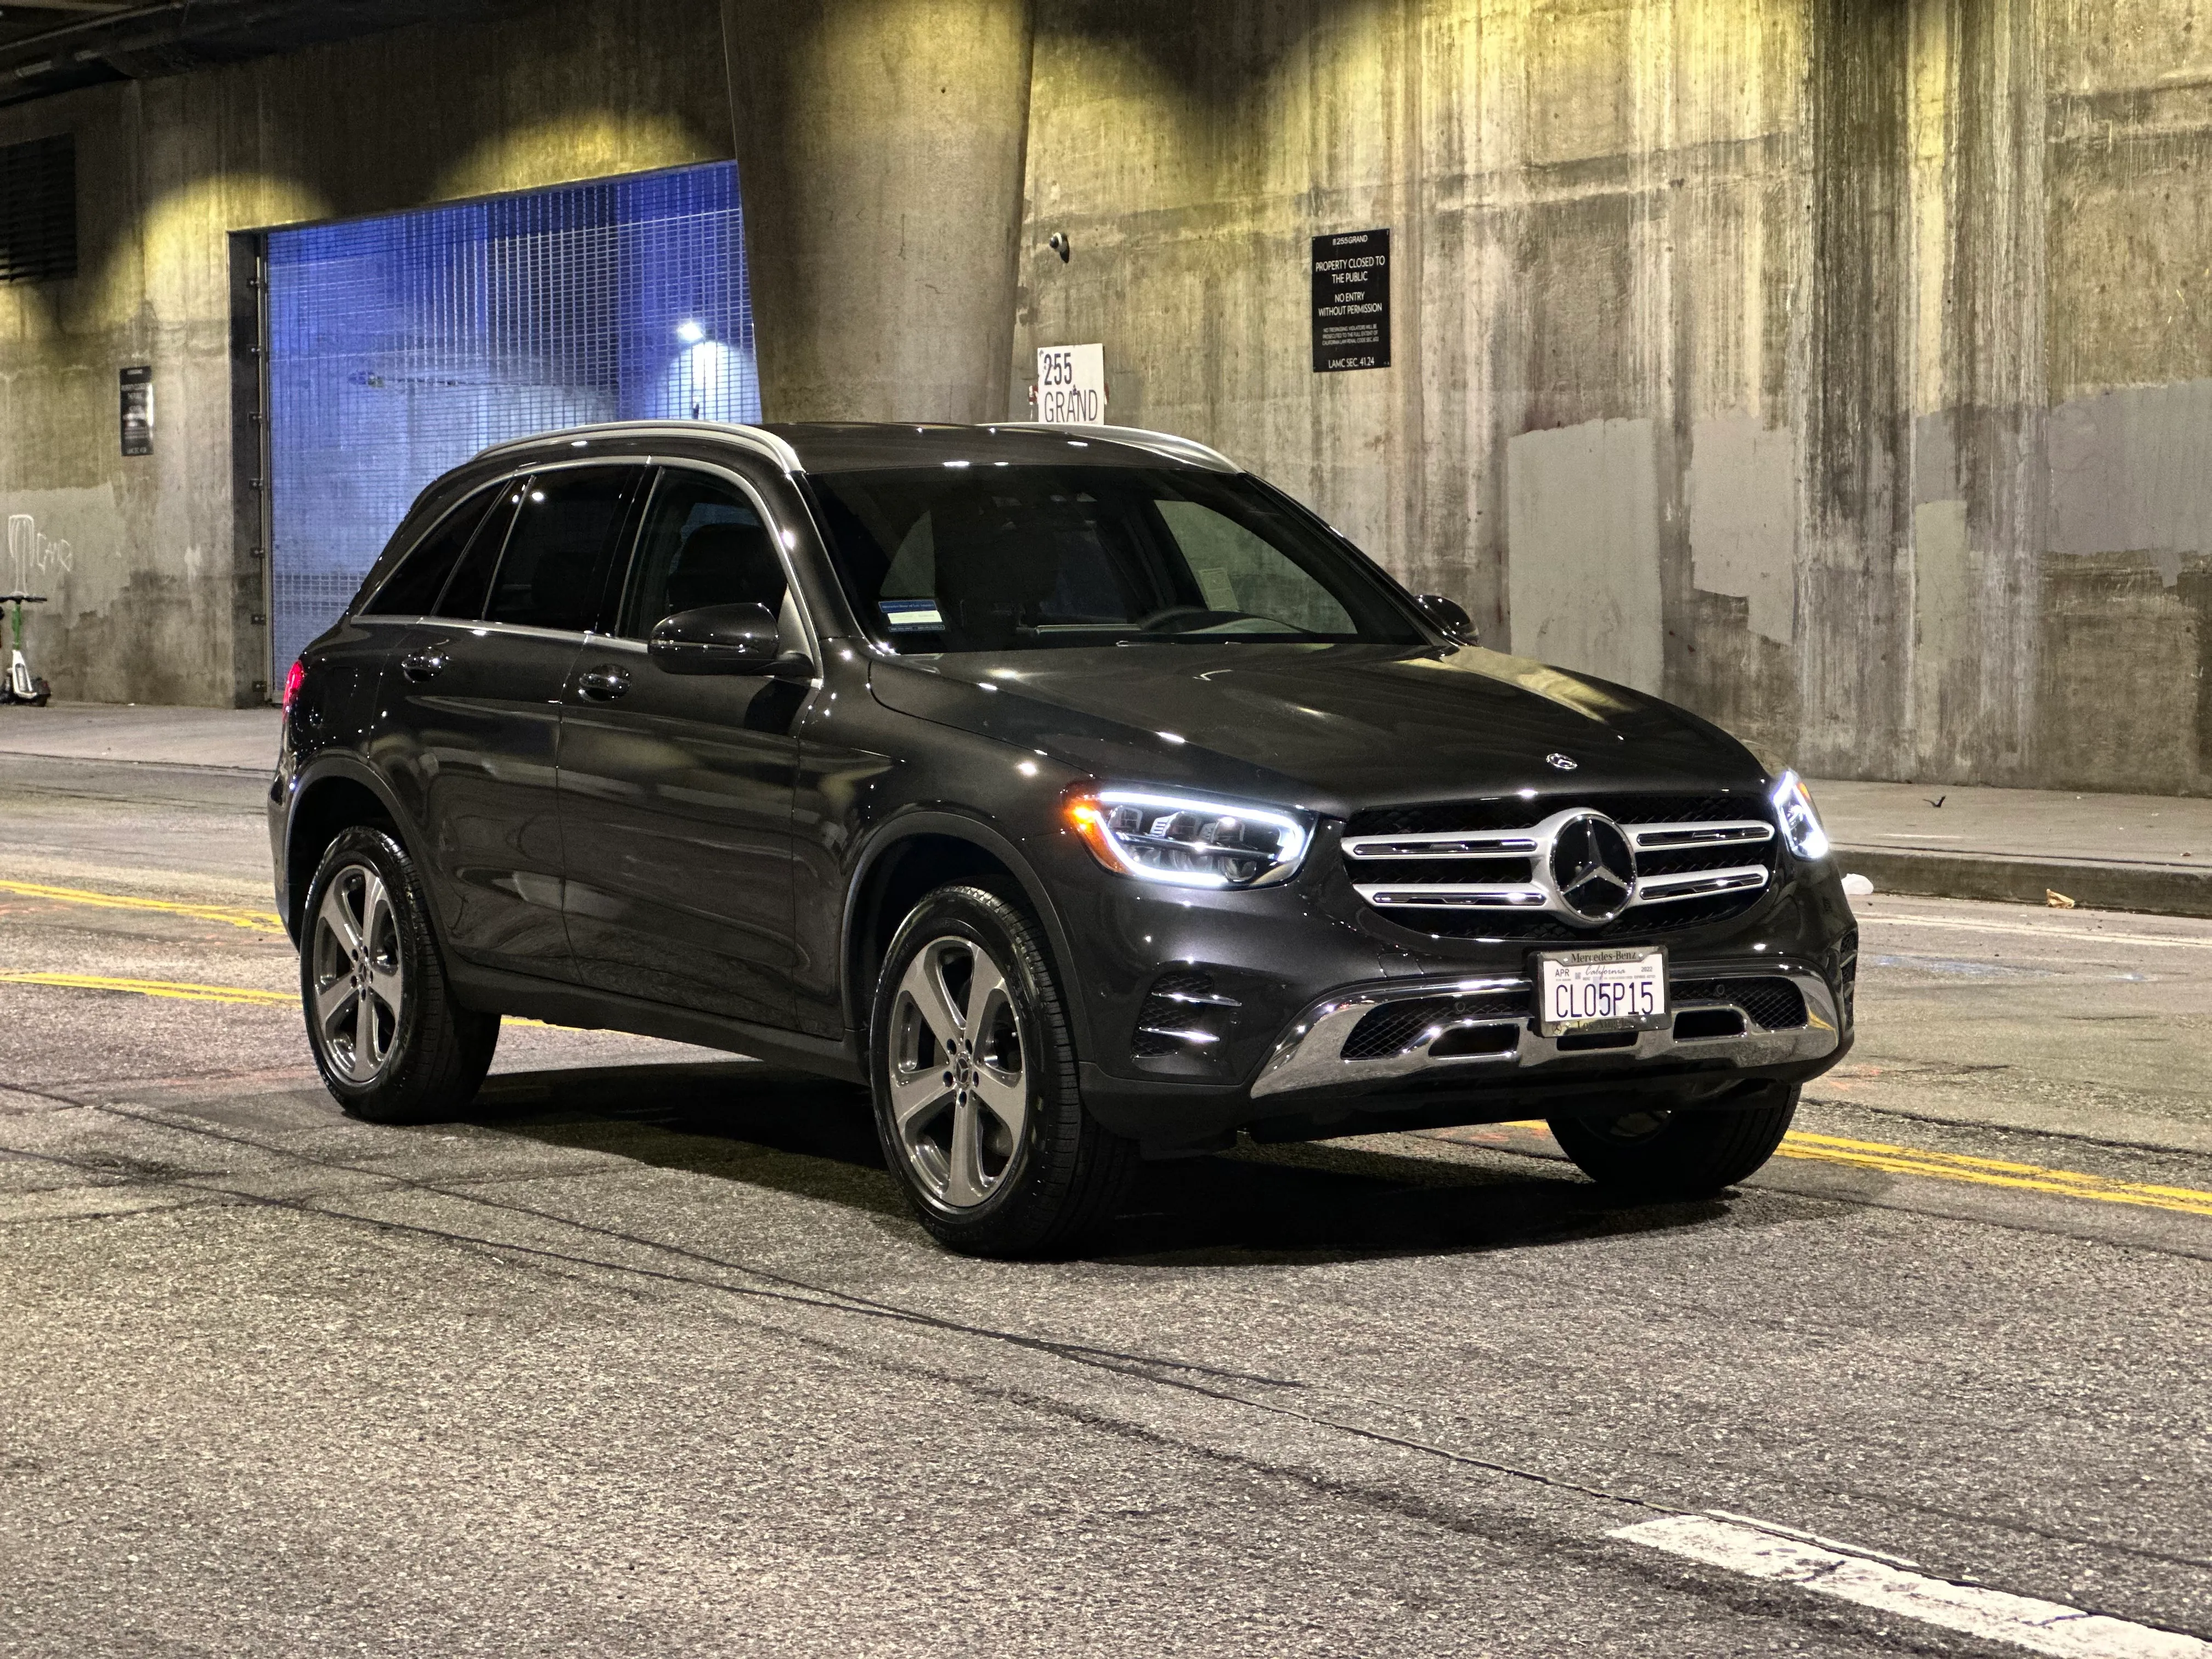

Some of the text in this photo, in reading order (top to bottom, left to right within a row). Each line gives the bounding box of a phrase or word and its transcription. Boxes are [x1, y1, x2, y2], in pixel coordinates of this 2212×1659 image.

[1336, 234, 1368, 245] 255 GRAND
[1316, 255, 1385, 272] PROPERTY CLOSED TO
[1332, 271, 1368, 284] THE PUBLIC
[1335, 291, 1365, 303] NO ENTRY
[1318, 303, 1382, 317] WITHOUT PERMISSION
[1044, 352, 1072, 385] 255
[1328, 358, 1345, 369] LAMC
[1045, 390, 1098, 422] GRAND
[1571, 951, 1636, 963] Mercedes-Benz
[1555, 969, 1570, 977] APR
[1585, 965, 1626, 980] California
